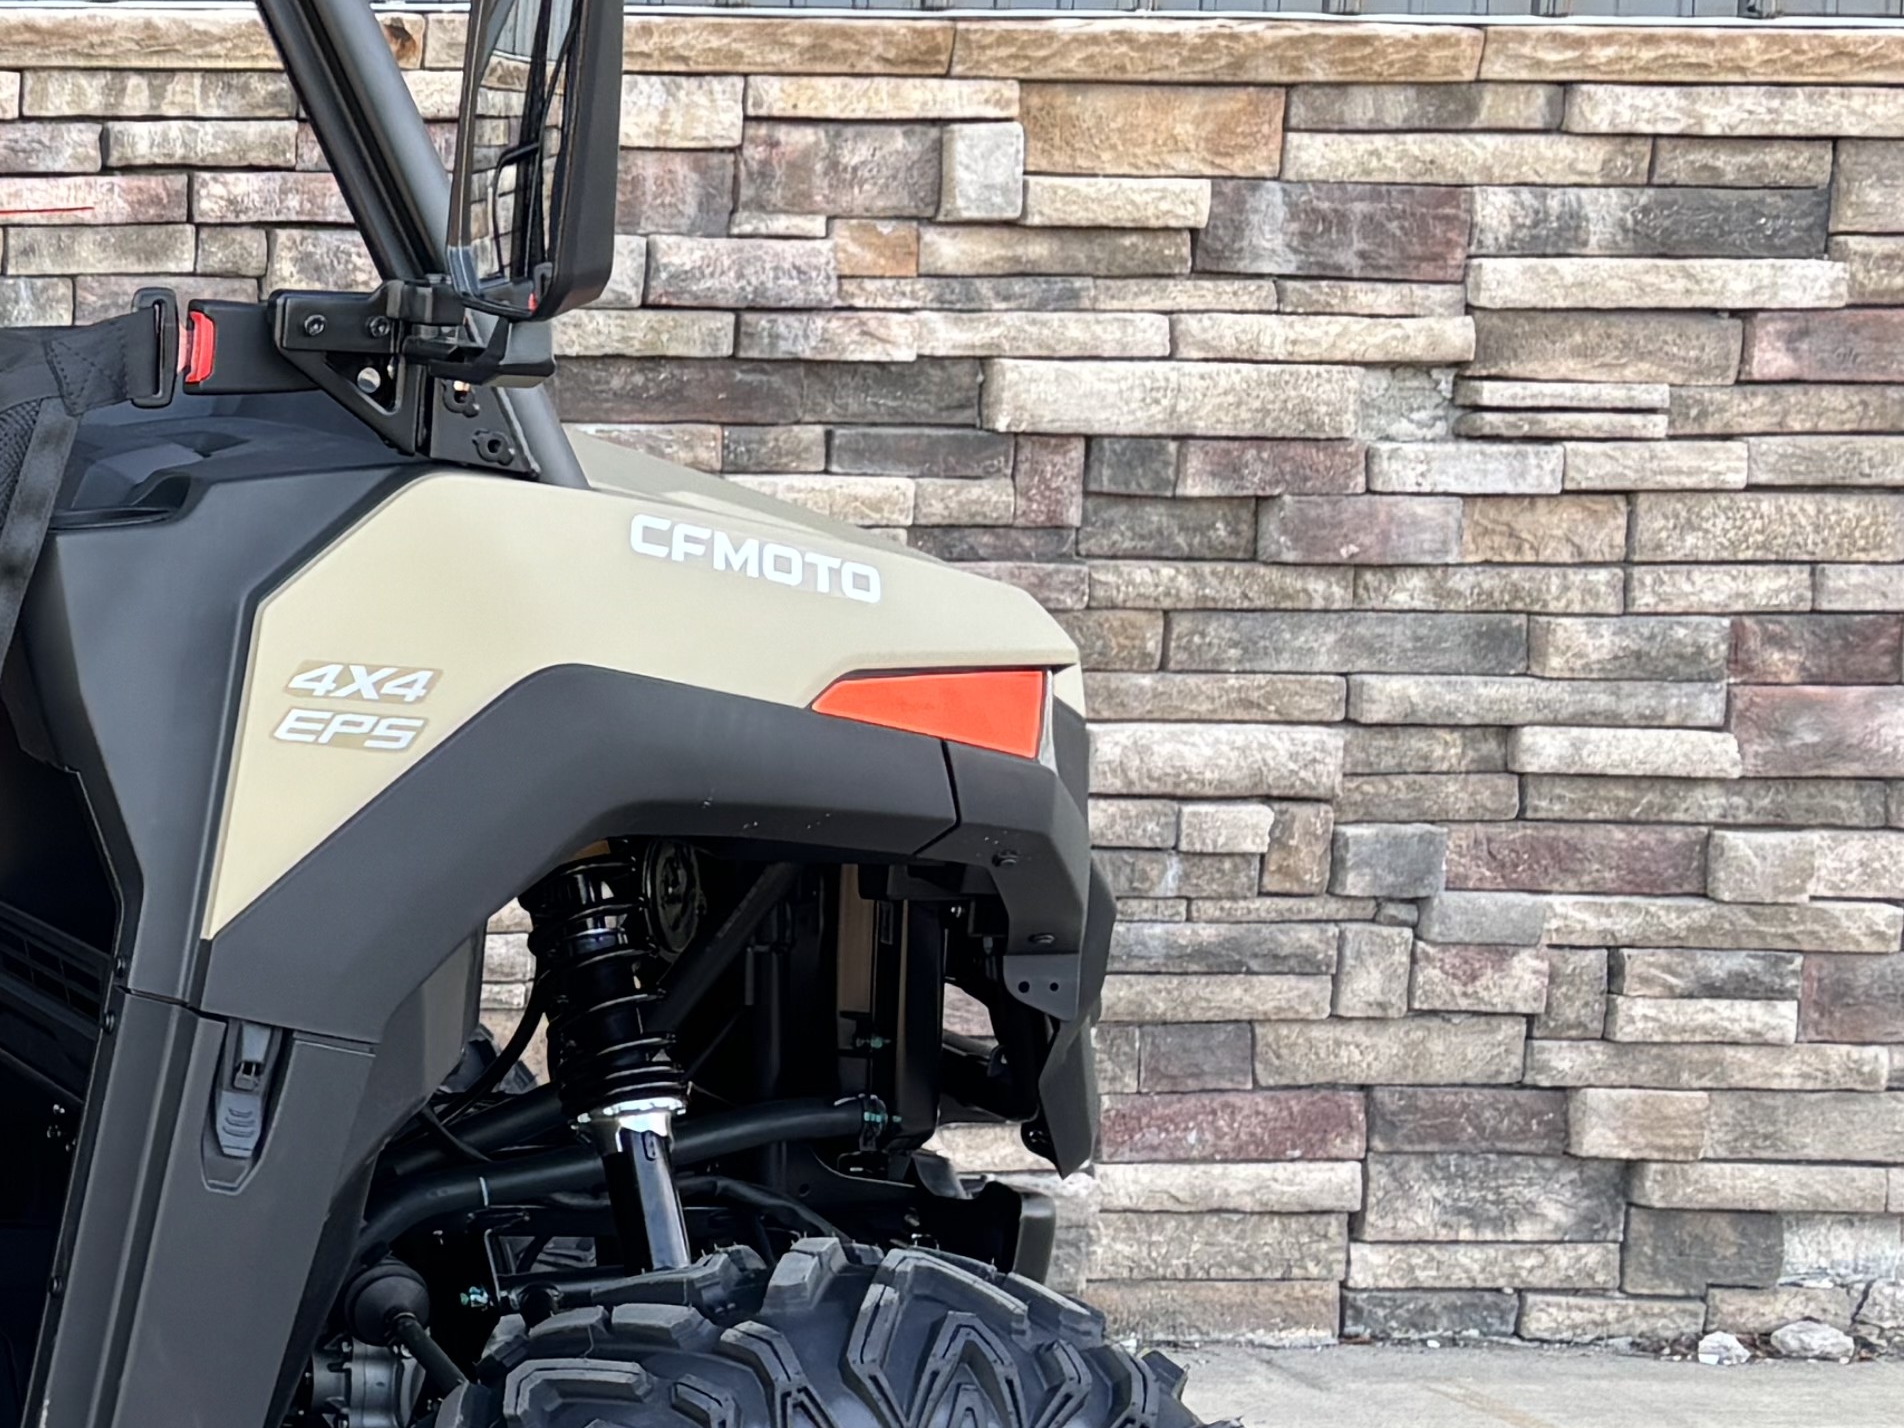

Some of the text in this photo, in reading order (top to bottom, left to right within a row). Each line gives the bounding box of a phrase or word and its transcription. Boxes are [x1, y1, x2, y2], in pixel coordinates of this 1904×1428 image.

[629, 513, 882, 604] CFMOTO
[287, 663, 435, 703] 4X4
[272, 707, 425, 750] EPS
